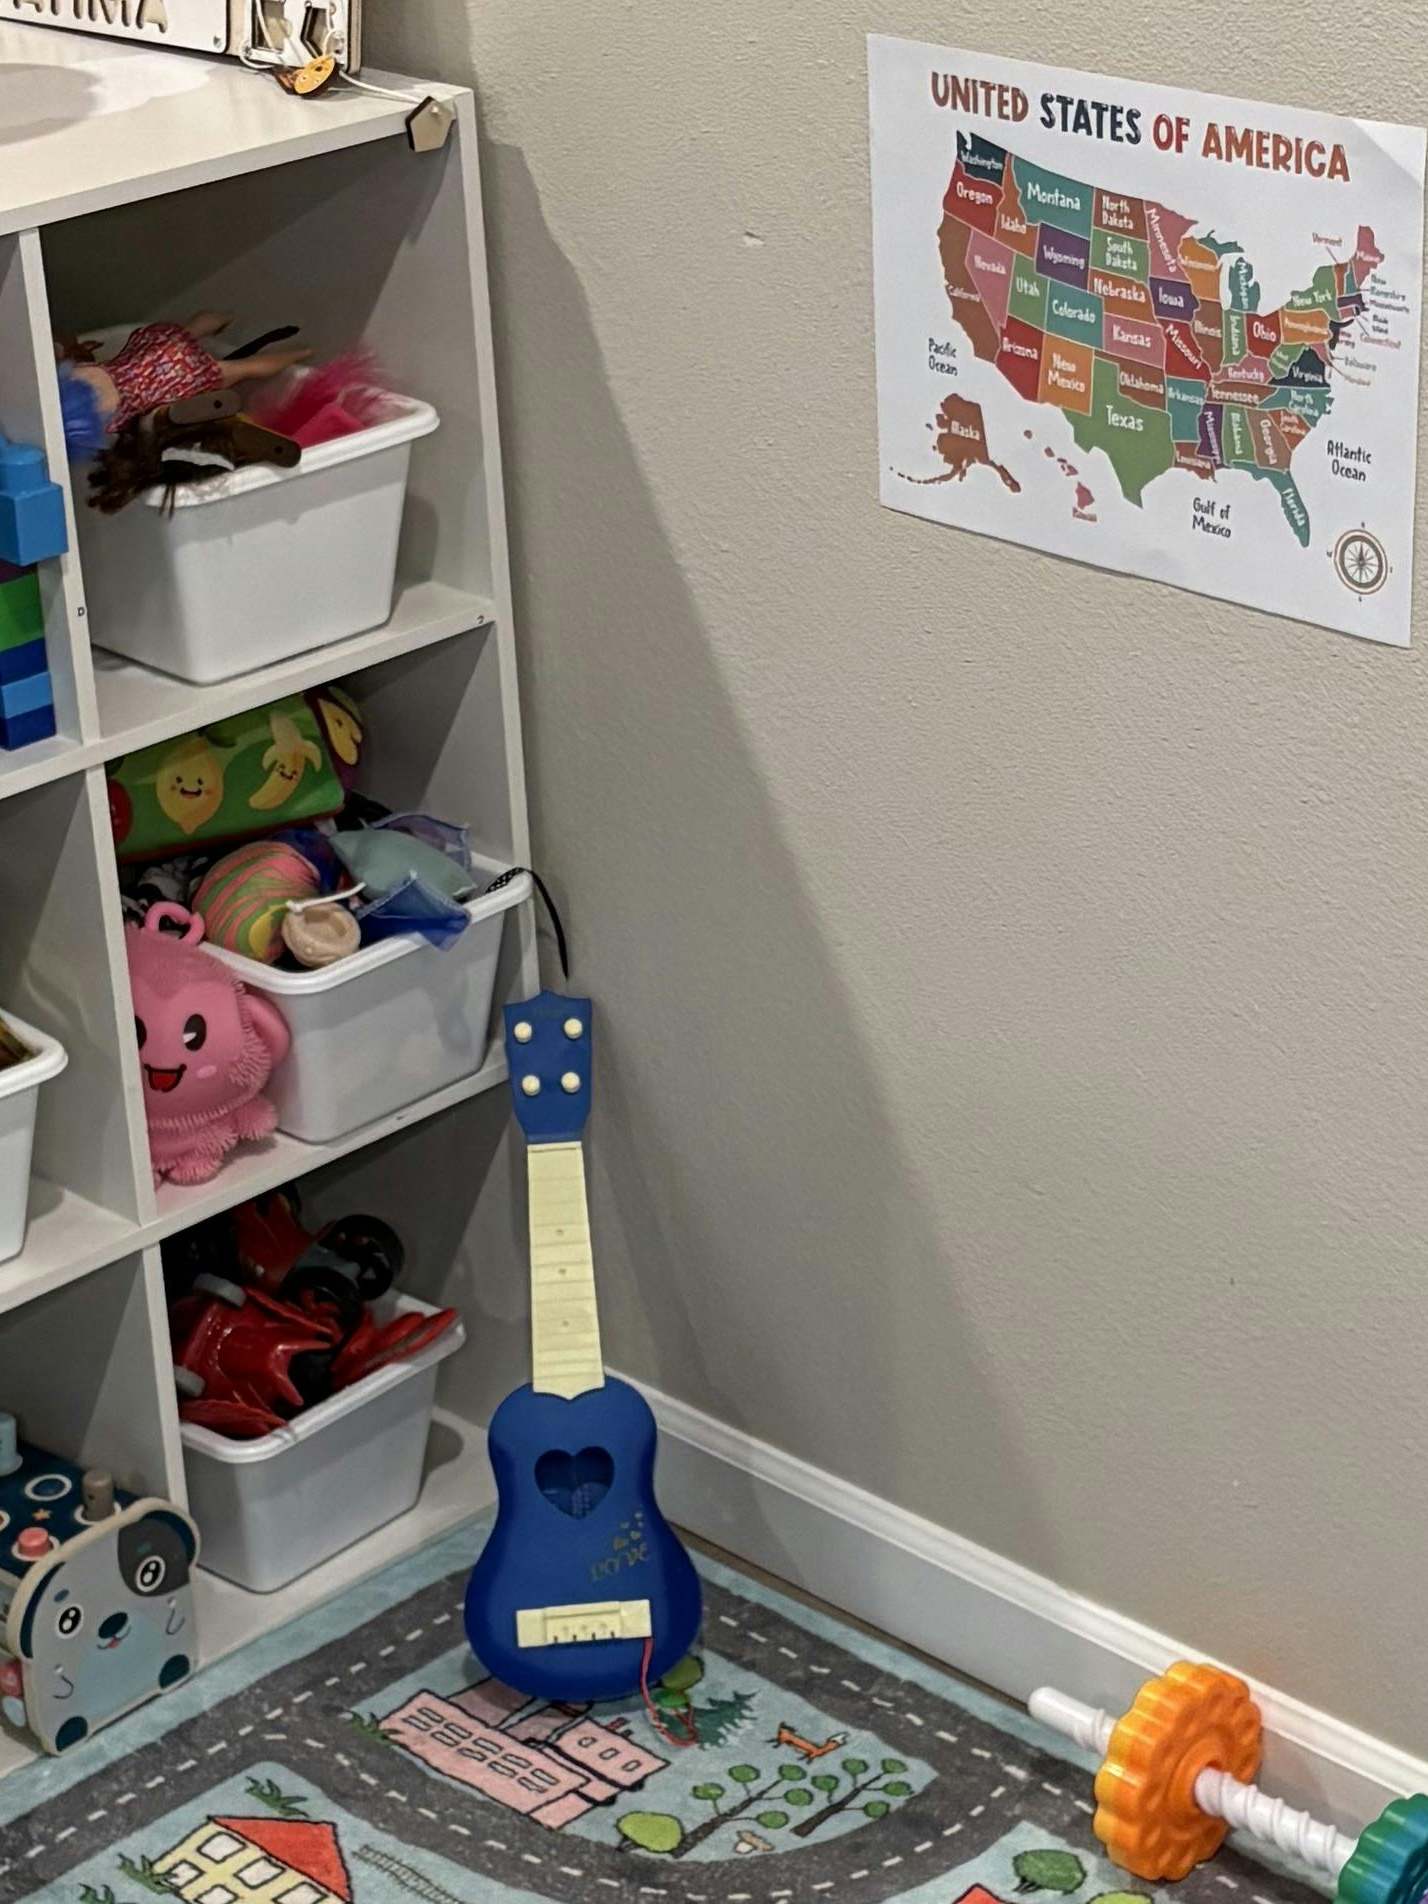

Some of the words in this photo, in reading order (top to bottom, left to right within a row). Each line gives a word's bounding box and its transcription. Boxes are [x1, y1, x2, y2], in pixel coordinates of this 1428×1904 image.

[931, 71, 1029, 122] UNITED
[1040, 92, 1142, 145] STATES
[1153, 112, 1190, 152] OF
[1202, 122, 1351, 182] AMERICA
[956, 181, 993, 205] Oregon
[1027, 182, 1081, 211] Montana
[1101, 195, 1130, 214] North
[1000, 213, 1027, 234] Idaho
[1101, 211, 1134, 231] Dakota
[1043, 244, 1086, 271] Wyoming
[1106, 236, 1134, 256] South
[1105, 251, 1138, 272] Dakota
[1015, 276, 1041, 298] Utah
[1093, 278, 1147, 304] Nebraska
[1158, 286, 1185, 309] Iowa
[1052, 299, 1097, 324] Colorado
[1112, 324, 1152, 349] Kansas
[1252, 321, 1277, 343] Ohio
[928, 337, 957, 359] Pacific
[1165, 324, 1203, 371] Missouri
[928, 354, 958, 377] Ocean
[1227, 367, 1265, 385] Kentucky
[1047, 370, 1086, 393] Mexico
[1119, 371, 1165, 395] Oklahoma
[1210, 386, 1260, 404] Tennessee
[1106, 404, 1144, 433] Texas
[1259, 418, 1278, 465] Georgia
[1326, 439, 1373, 466] Atlantic
[1331, 459, 1367, 483] Ocean
[1192, 497, 1216, 517] Gulf
[1219, 504, 1232, 521] of
[1192, 514, 1232, 539] Mexico
